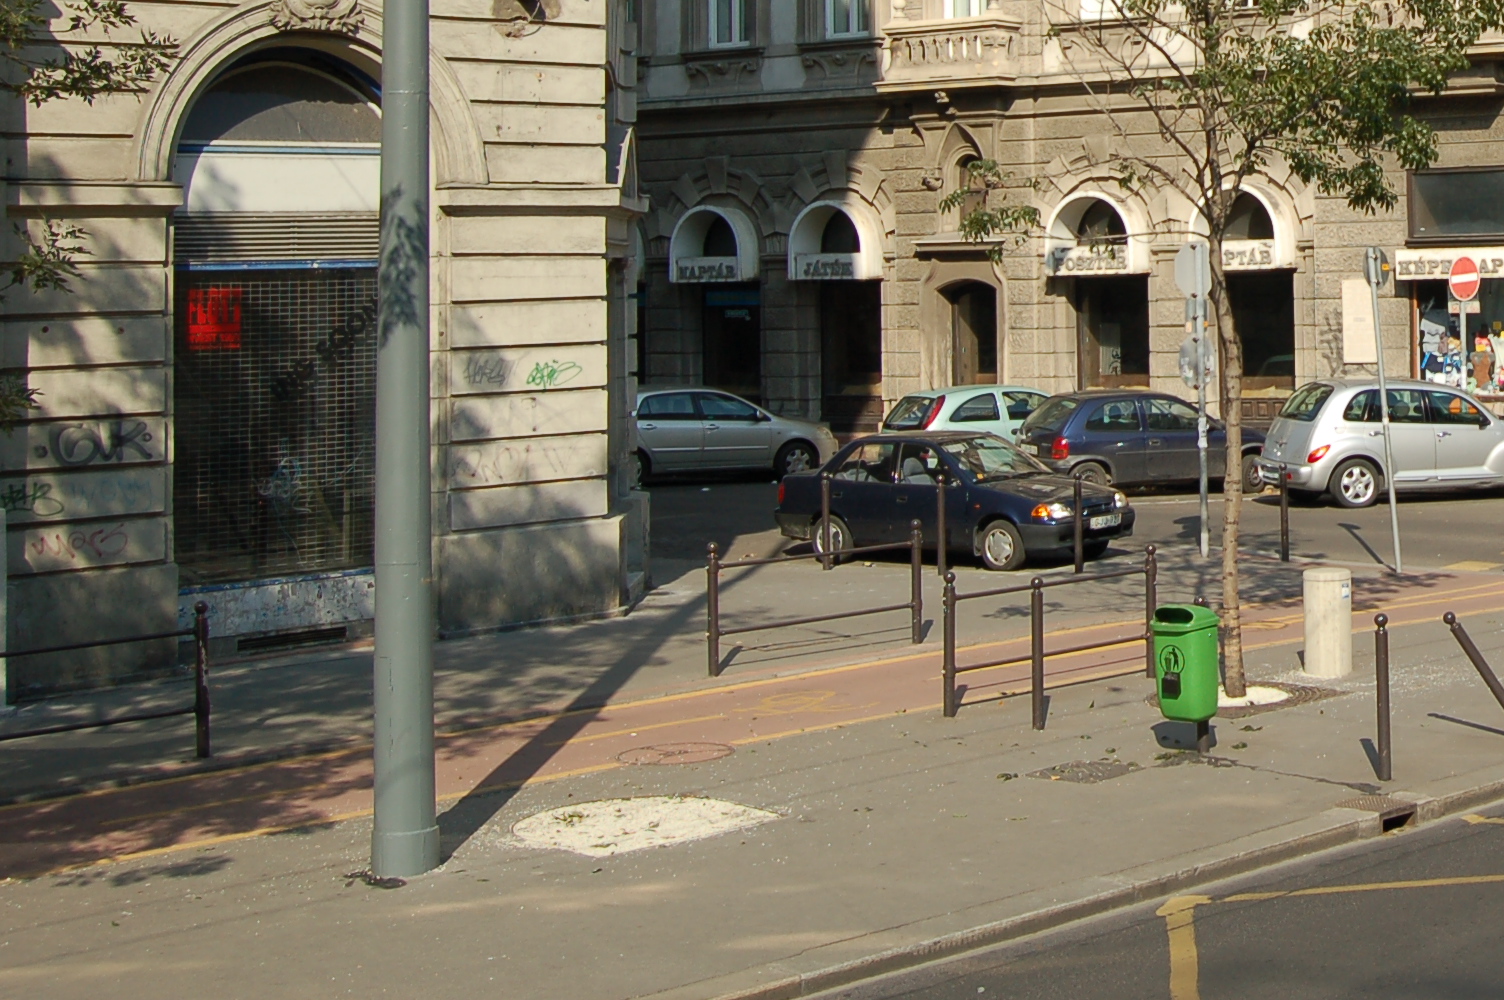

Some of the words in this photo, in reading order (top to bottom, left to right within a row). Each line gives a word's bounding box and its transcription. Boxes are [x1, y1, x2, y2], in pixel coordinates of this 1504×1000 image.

[1223, 246, 1273, 266] PTÁR
[1398, 256, 1504, 276] KÉPEAP
[679, 263, 736, 279] NAPTÁR
